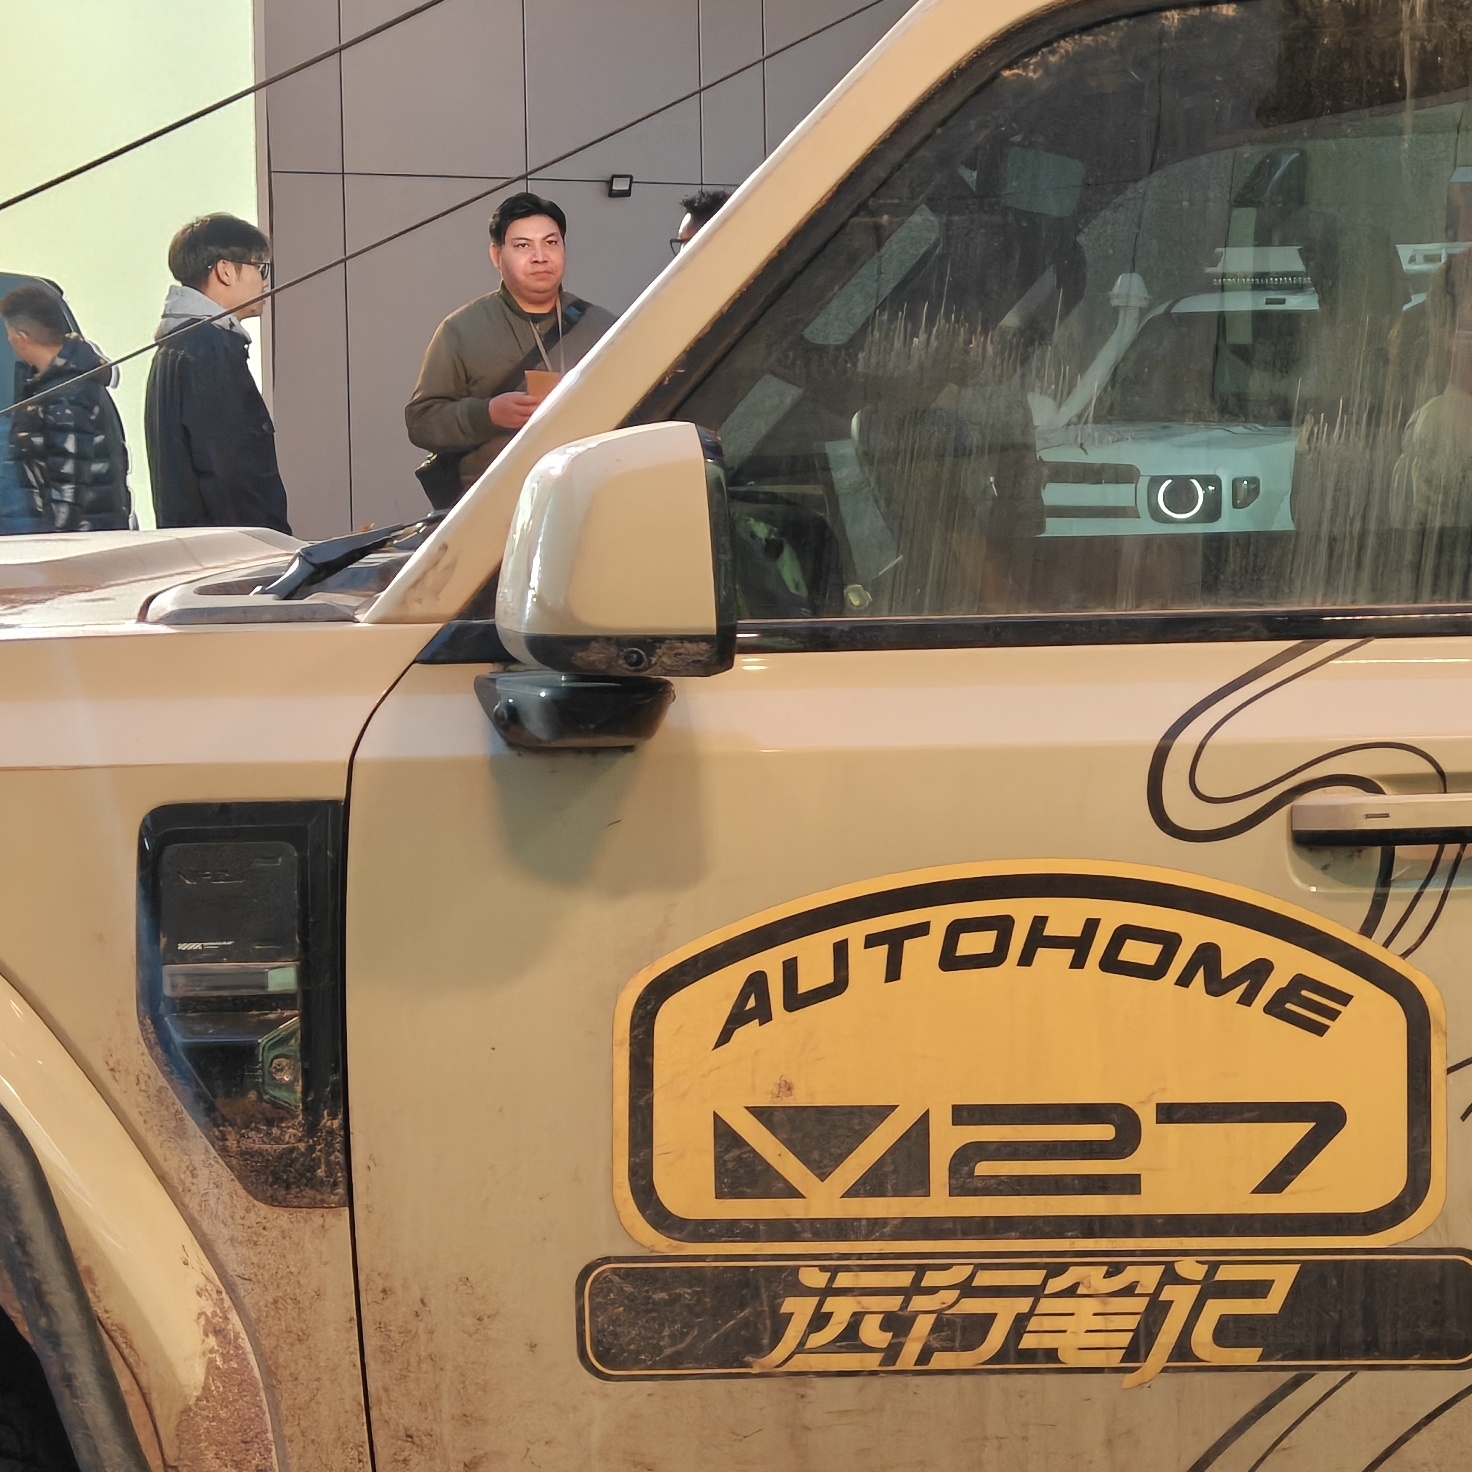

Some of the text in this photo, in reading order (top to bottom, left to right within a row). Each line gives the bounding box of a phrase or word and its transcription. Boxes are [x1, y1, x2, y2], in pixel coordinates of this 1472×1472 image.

[711, 914, 1354, 1051] AUTOHOME
[750, 1259, 1301, 1390] 远行笔记
